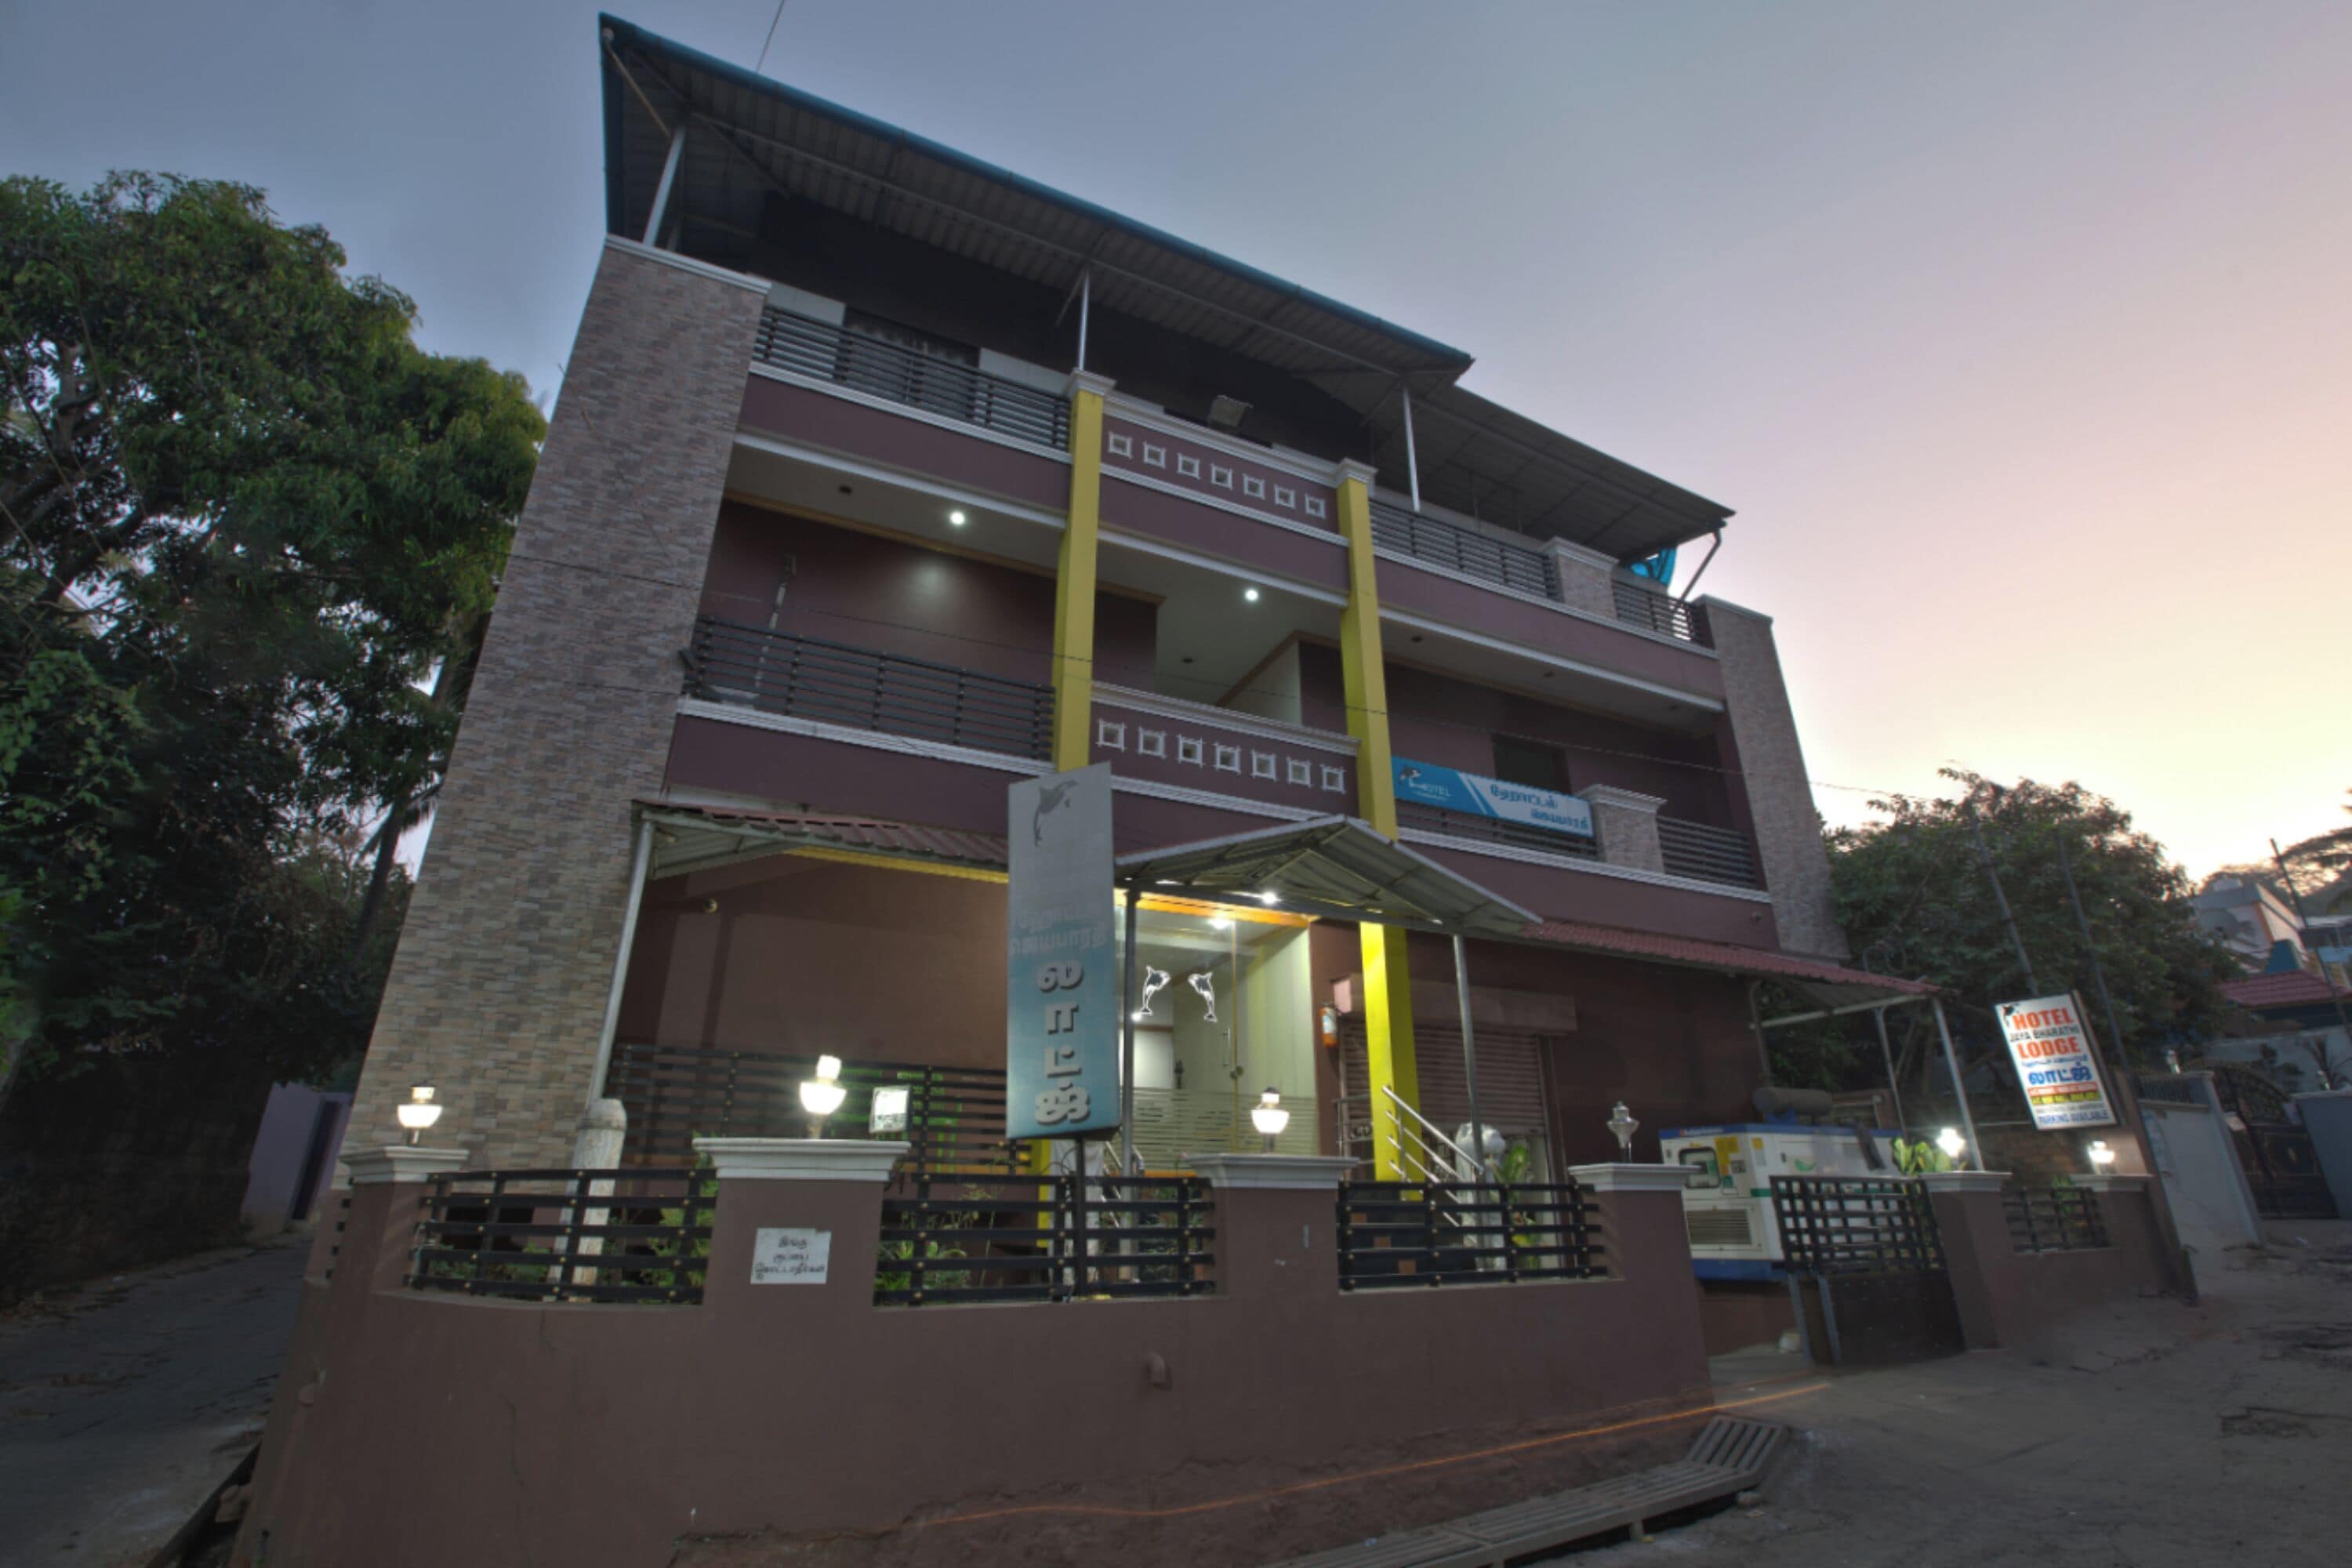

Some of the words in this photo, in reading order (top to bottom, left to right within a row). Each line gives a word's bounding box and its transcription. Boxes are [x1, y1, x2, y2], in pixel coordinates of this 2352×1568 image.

[2012, 1007, 2074, 1031] HOTEL
[2016, 1036, 2082, 1058] LODGE
[2028, 1062, 2092, 1085] லாட்ஜ்
